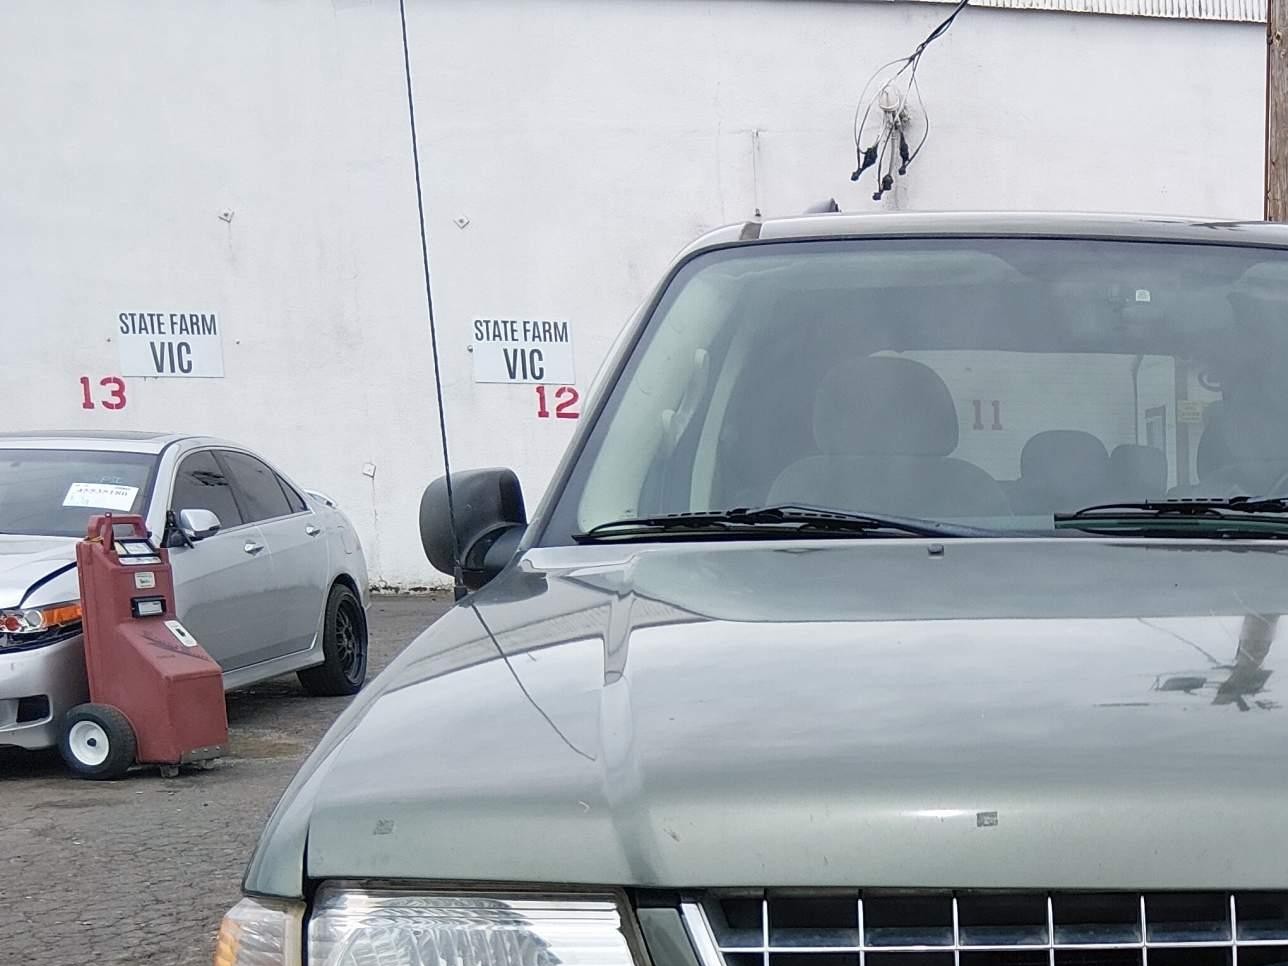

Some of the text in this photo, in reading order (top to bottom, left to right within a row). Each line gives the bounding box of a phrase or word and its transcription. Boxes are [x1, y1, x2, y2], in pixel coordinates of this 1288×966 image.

[119, 312, 217, 336] STATE FARM
[474, 319, 569, 343] STATE FARM
[149, 341, 193, 374] VIC
[503, 348, 545, 381] VIC
[80, 375, 127, 411] 13
[535, 385, 580, 419] 12
[971, 399, 1003, 431] 11
